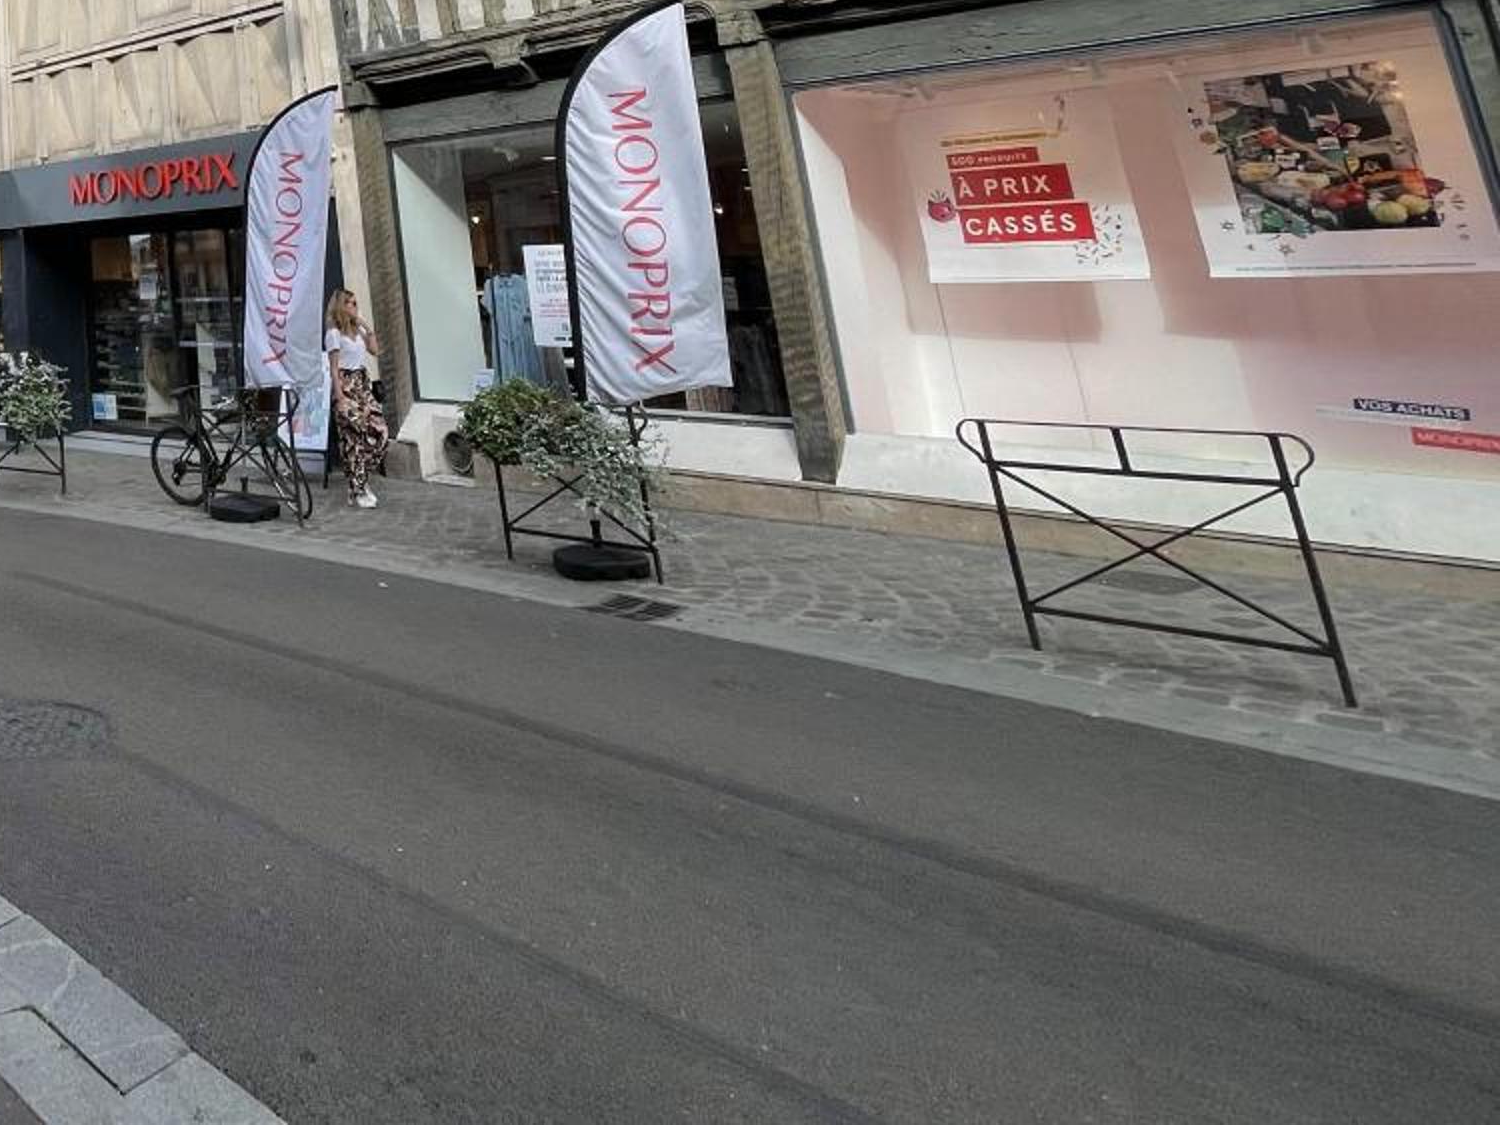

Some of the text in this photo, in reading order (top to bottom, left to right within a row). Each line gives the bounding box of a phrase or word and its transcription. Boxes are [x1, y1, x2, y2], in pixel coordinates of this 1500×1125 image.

[68, 149, 239, 207] MONOPRIX
[958, 174, 1051, 198] À PRIX
[606, 87, 678, 376] MONOPRIX
[965, 208, 1077, 236] CASSÉS
[262, 151, 305, 366] MONOPRIX
[1358, 399, 1466, 419] VOS ACHATS
